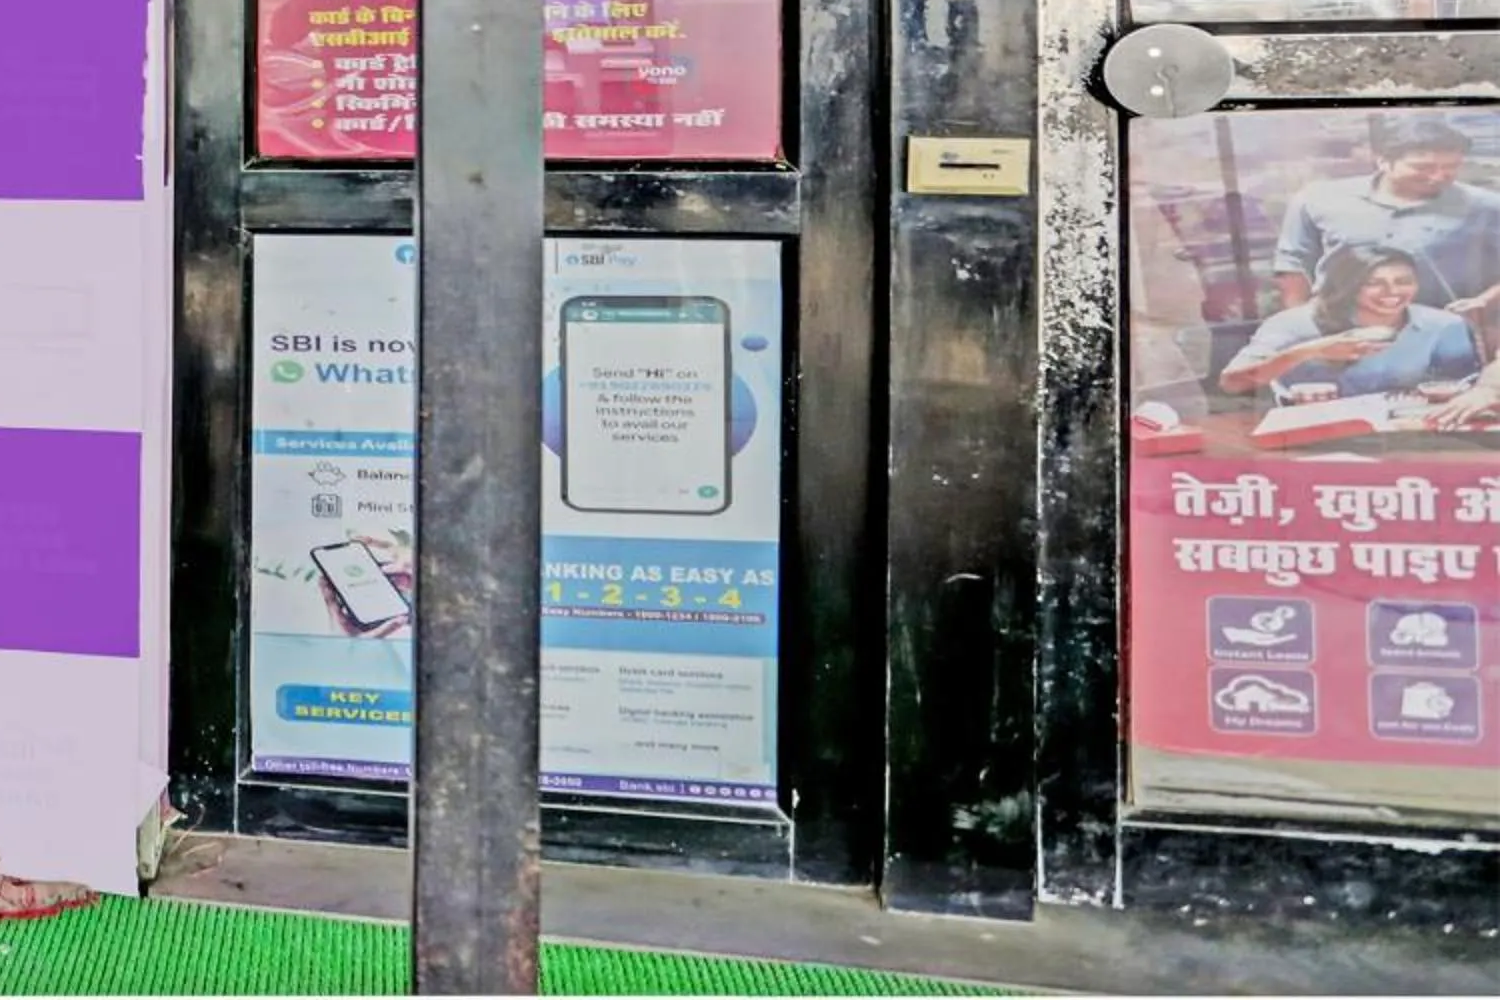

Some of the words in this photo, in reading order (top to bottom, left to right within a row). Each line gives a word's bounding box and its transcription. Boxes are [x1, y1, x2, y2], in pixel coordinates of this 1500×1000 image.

[270, 335, 322, 353] SBI
[332, 335, 358, 353] is
[314, 362, 415, 385] What
[275, 436, 357, 450] Services
[542, 562, 624, 581] NKING
[630, 565, 663, 582] AS
[670, 566, 736, 585] EASY
[741, 569, 775, 586] AS
[1350, 542, 1482, 584] पाइए
[548, 581, 562, 602] 1
[602, 583, 624, 606] 2
[659, 585, 682, 608] 3
[718, 586, 742, 609] 4
[329, 690, 380, 704] KEY
